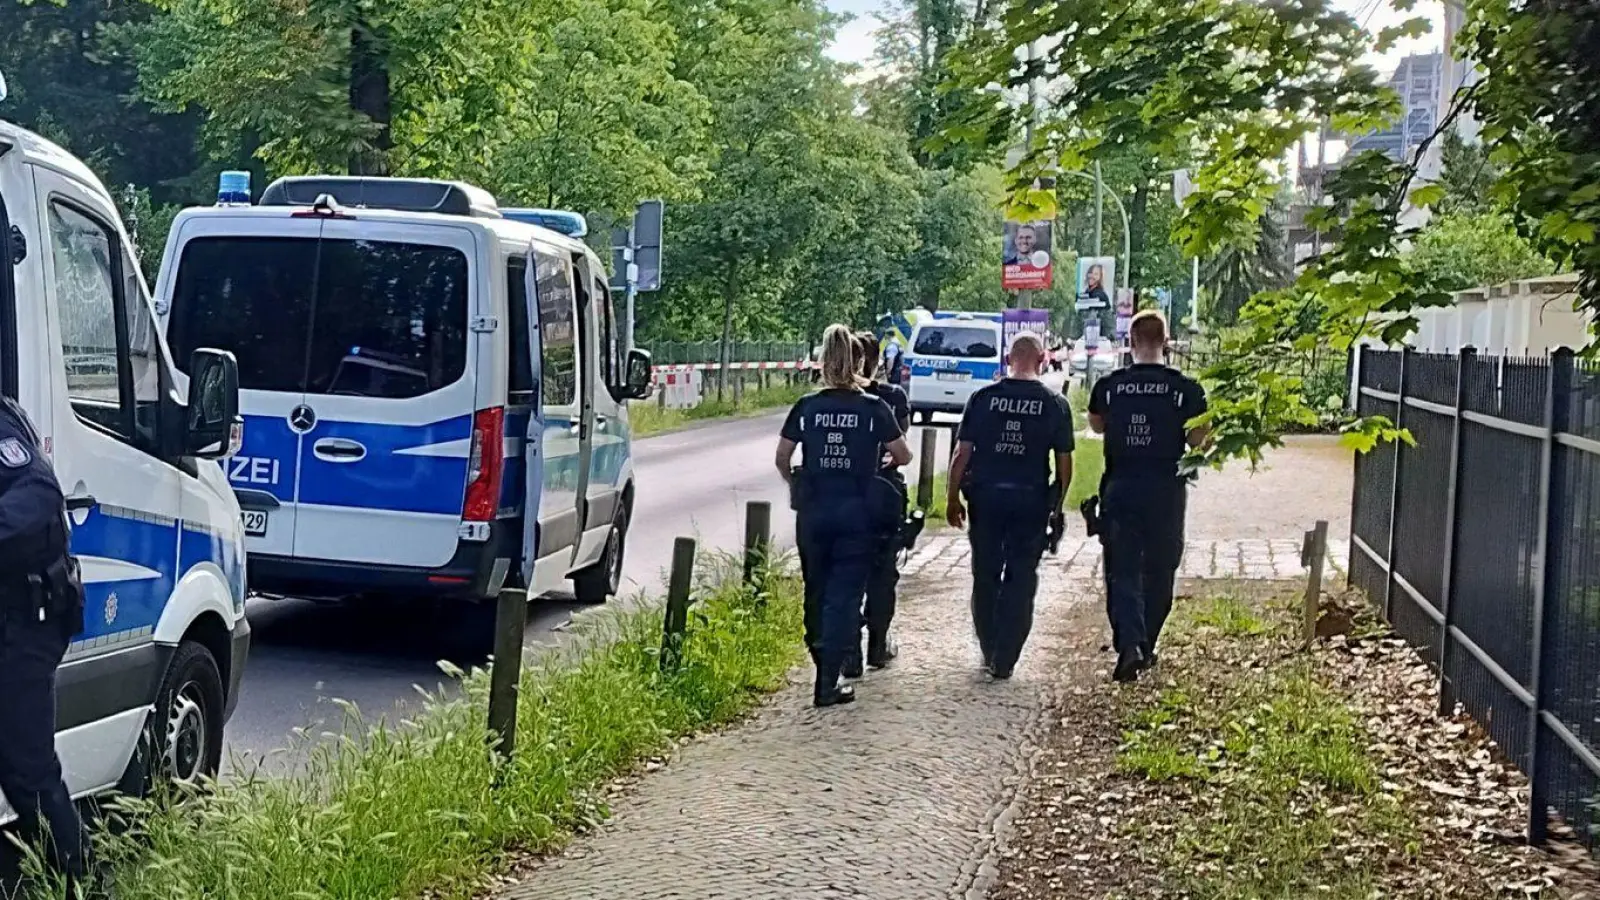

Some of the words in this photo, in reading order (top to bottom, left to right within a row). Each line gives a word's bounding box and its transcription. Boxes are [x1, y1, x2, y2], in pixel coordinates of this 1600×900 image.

[912, 358, 948, 369] POLIZEI
[1117, 383, 1169, 395] POLIZEI
[990, 396, 1044, 416] POLIZEI
[815, 413, 859, 428] POLIZEI
[1131, 414, 1146, 424] BB
[1006, 420, 1021, 431] BB
[1128, 425, 1150, 435] 1132
[828, 433, 843, 444] BB
[1001, 432, 1023, 442] 1133
[1126, 436, 1152, 447] 11347
[824, 445, 847, 456] 1133
[820, 458, 851, 469] 16859
[241, 512, 264, 530] 29
